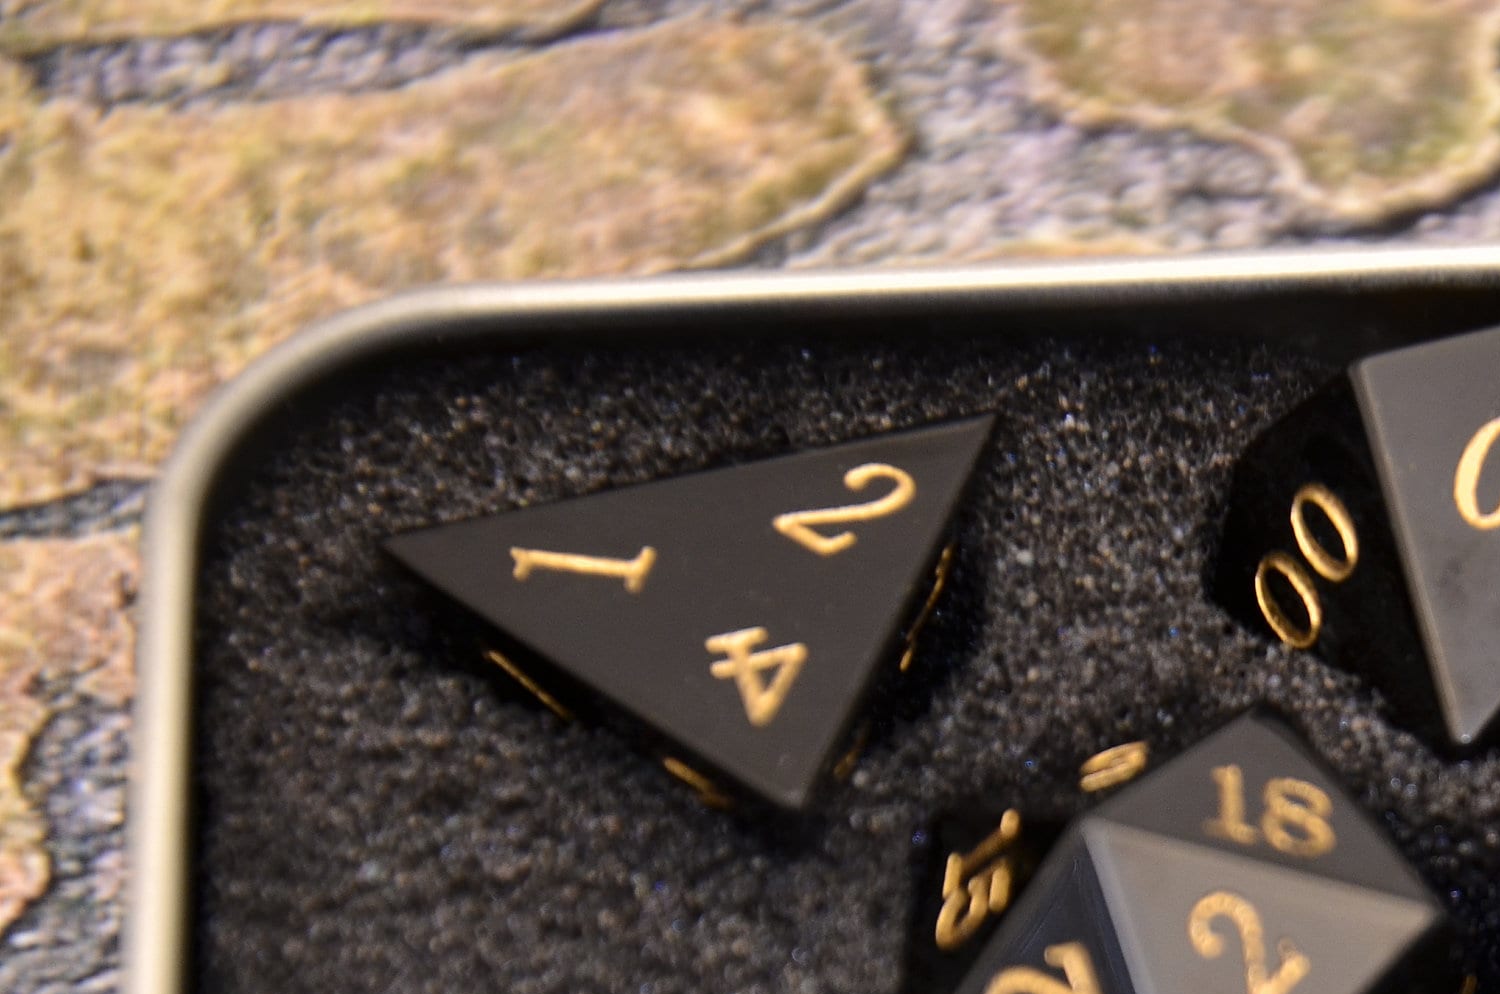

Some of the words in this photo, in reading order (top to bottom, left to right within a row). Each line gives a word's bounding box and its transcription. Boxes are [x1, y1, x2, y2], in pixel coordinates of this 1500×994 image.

[772, 462, 918, 557] 2
[510, 545, 658, 594] 1
[1254, 482, 1359, 650] 00
[705, 627, 808, 727] 4
[1205, 764, 1336, 856] 18
